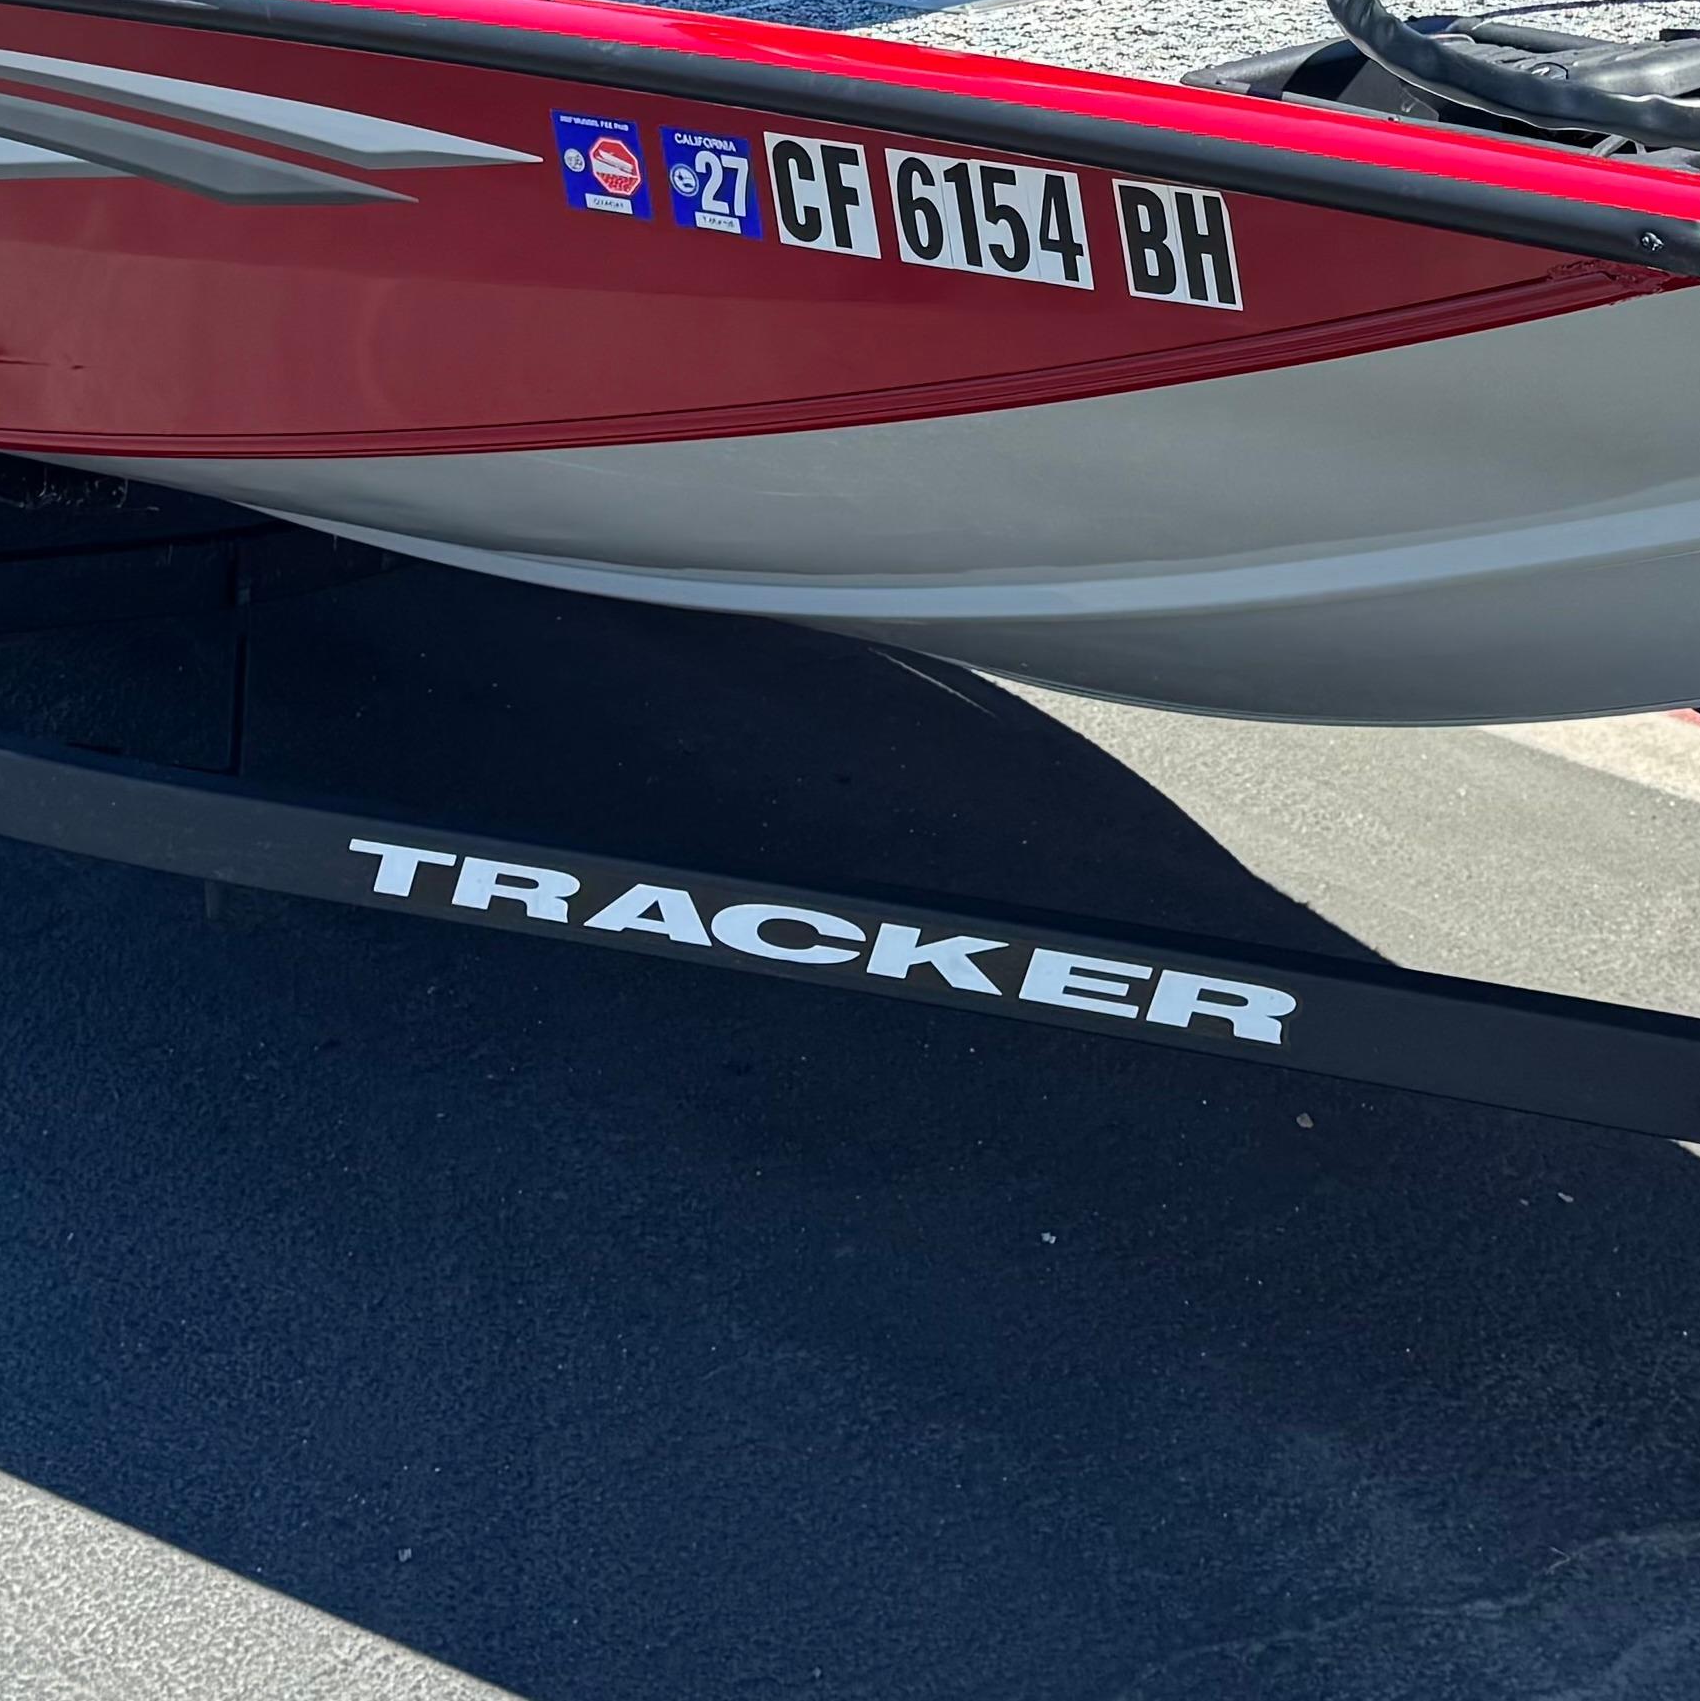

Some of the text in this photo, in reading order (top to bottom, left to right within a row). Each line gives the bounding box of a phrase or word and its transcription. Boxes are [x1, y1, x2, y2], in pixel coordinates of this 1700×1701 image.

[674, 132, 736, 152] CALIFORNIA
[694, 150, 749, 217] 27
[772, 139, 1237, 305] CF 6154 BH
[349, 837, 1297, 1045] TRACKER
